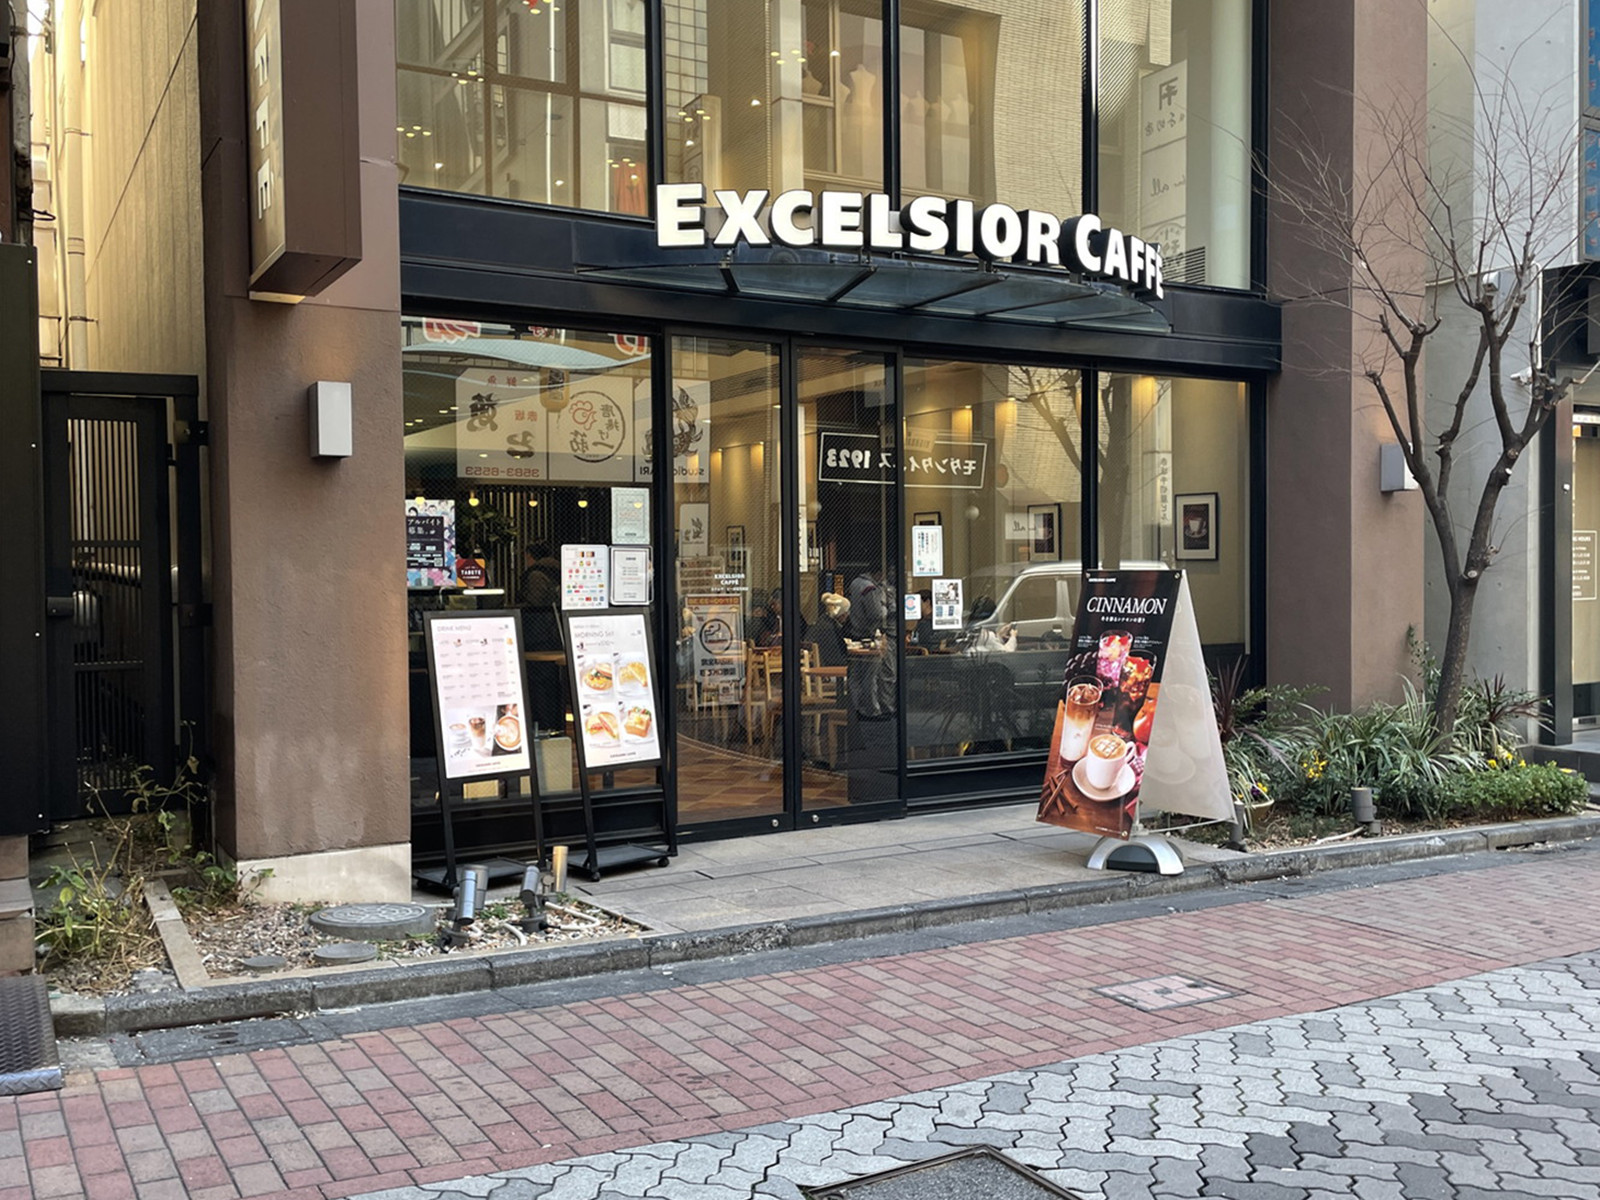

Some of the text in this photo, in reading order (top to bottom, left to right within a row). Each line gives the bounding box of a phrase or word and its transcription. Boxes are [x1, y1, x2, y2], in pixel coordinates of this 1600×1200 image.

[656, 183, 1061, 265] EXCELSIOR
[1074, 213, 1164, 299] CAFFÉ
[1086, 596, 1168, 615] CINNAMON
